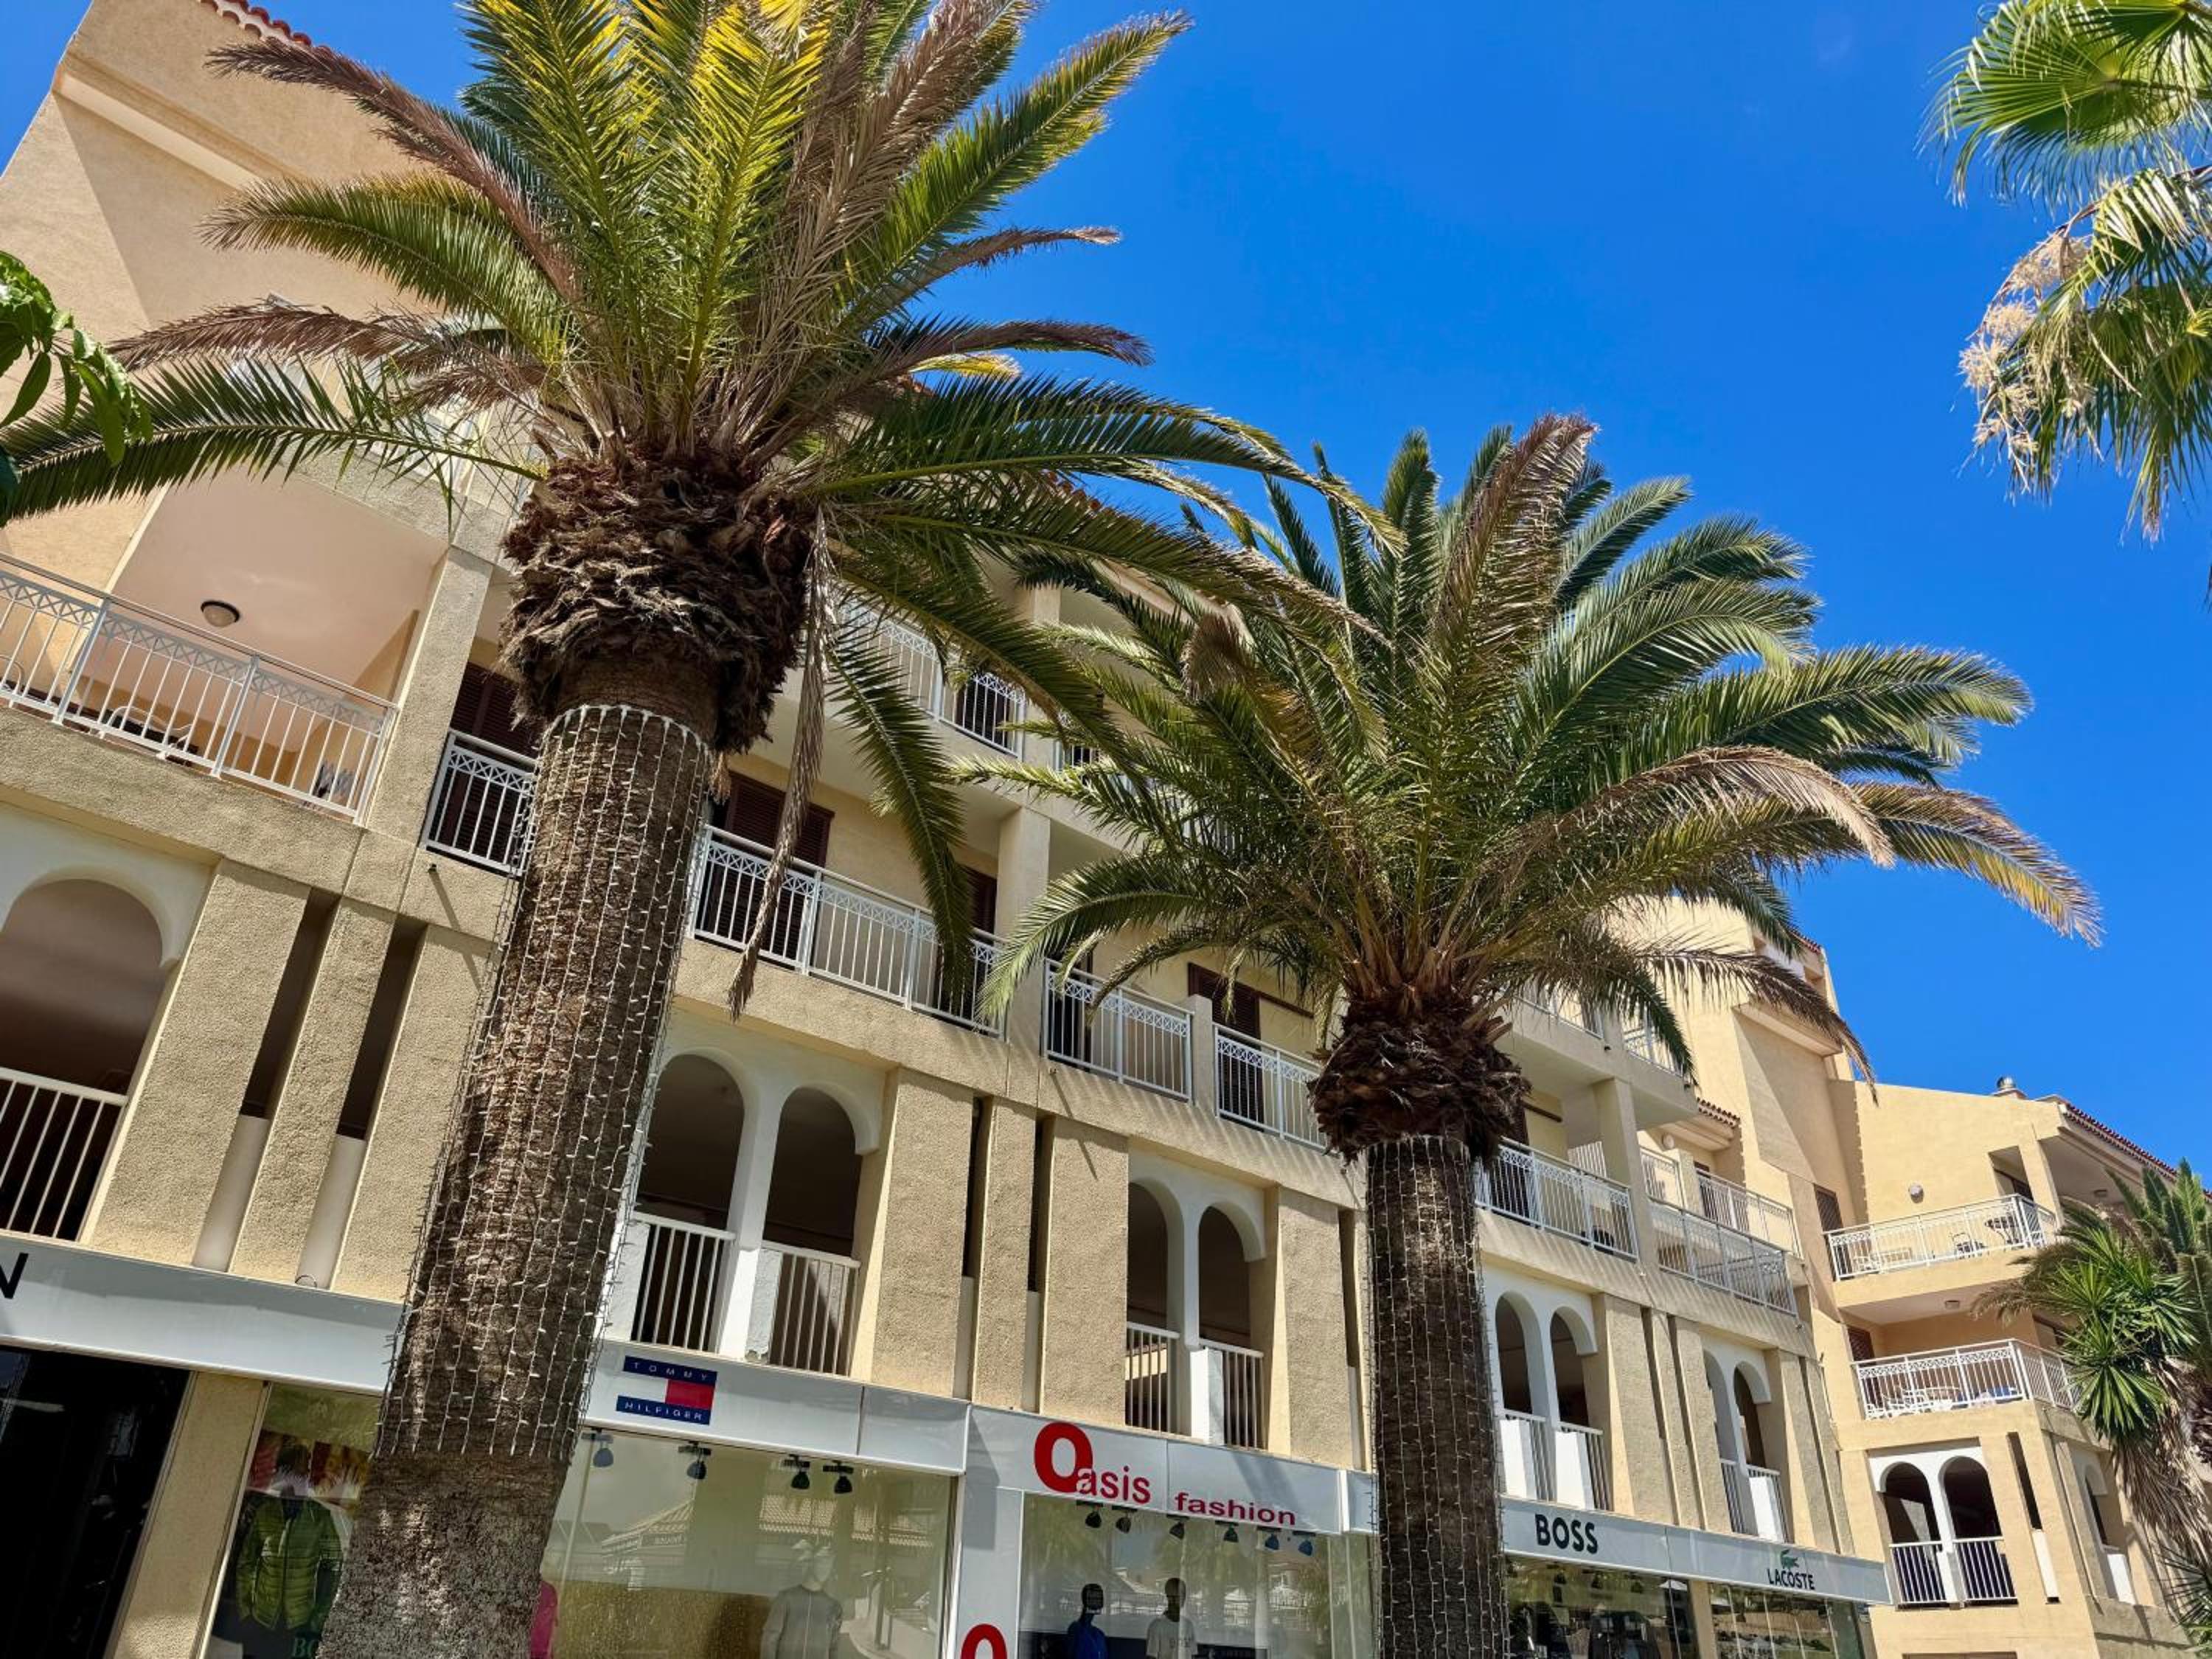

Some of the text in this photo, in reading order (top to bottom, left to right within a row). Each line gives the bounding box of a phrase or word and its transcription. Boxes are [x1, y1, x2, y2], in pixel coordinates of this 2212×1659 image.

[632, 1361, 707, 1381] TOMMY
[625, 1402, 703, 1421] HILFIGER
[1034, 1422, 1295, 1526] Oasis fashion
[1535, 1514, 1599, 1554] BOSS
[1767, 1568, 1815, 1590] LACOSTE
